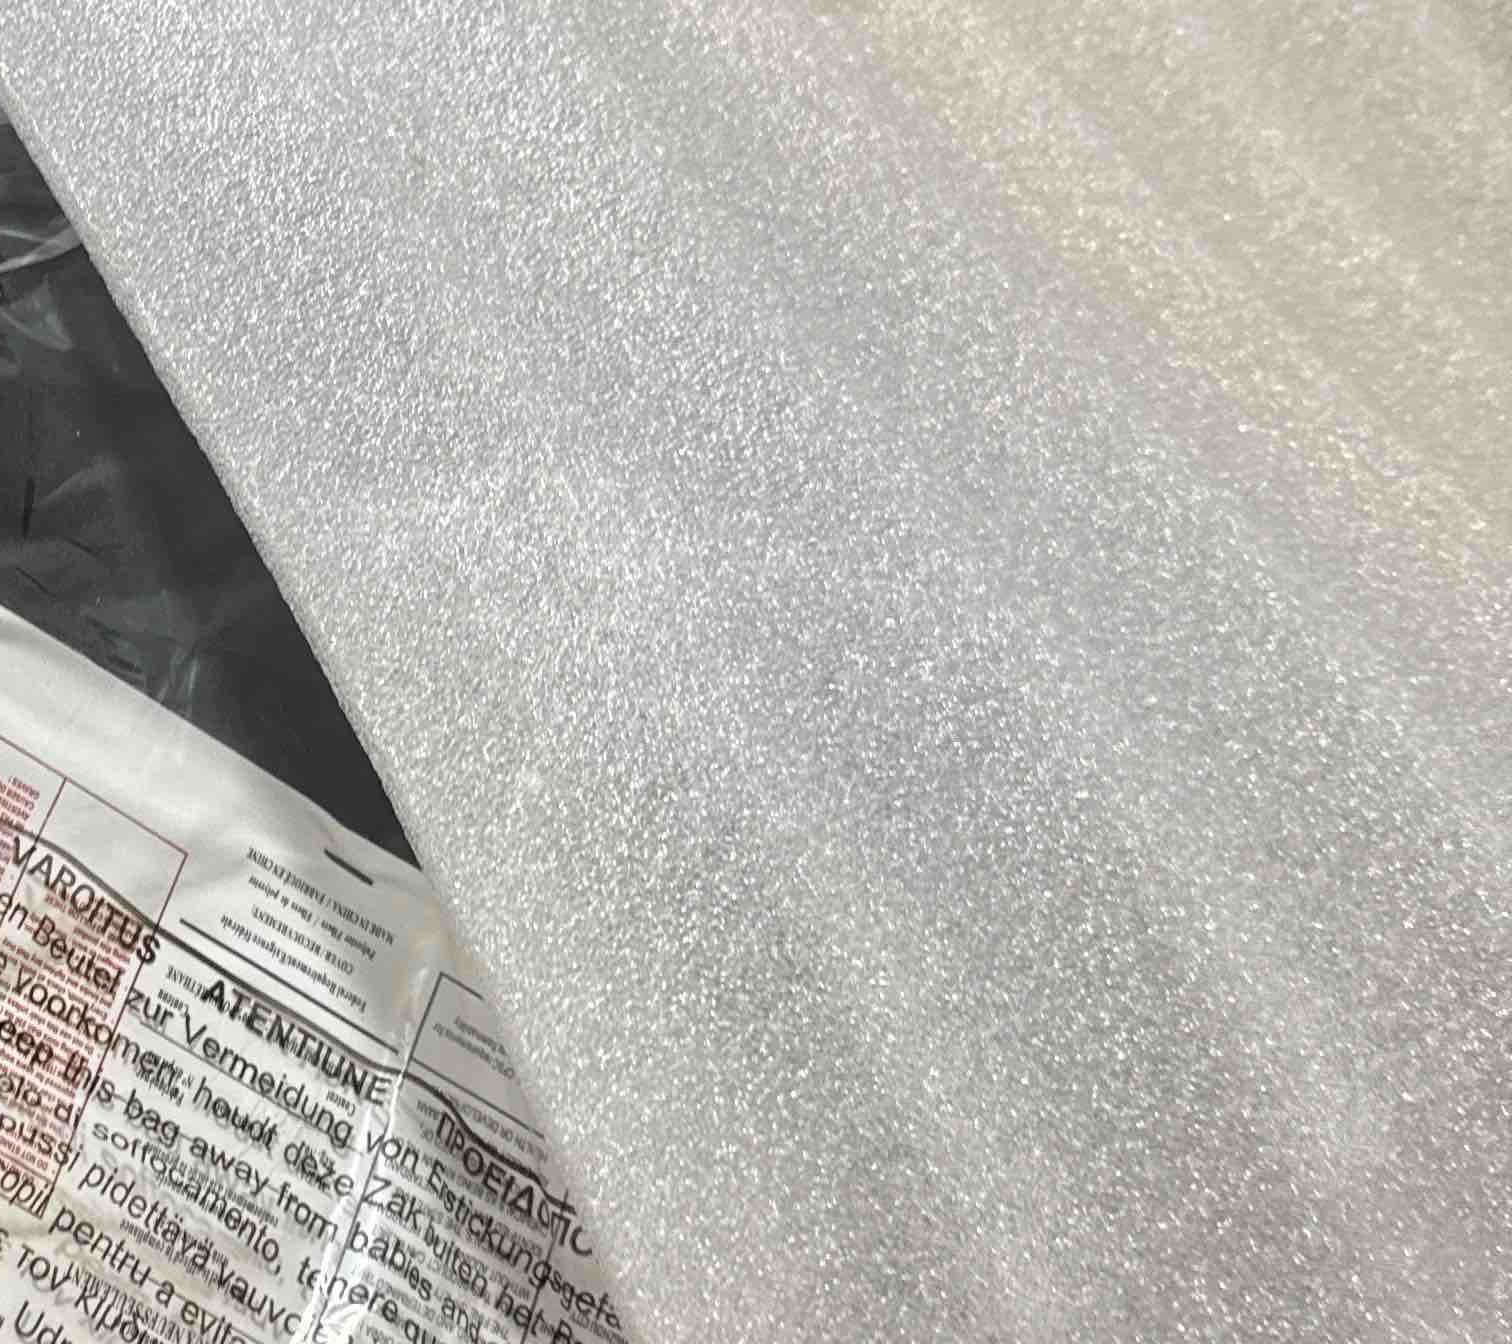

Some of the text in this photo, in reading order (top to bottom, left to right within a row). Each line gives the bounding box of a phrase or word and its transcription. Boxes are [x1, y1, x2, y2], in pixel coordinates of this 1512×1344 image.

[3, 834, 168, 968] VAROITUS
[199, 972, 398, 1110] ATENTIUNE
[28, 914, 128, 999] Beutel
[123, 982, 177, 1031] zur
[170, 1012, 361, 1152] Vermeidung
[359, 1126, 425, 1172] von
[49, 1097, 88, 1131] di
[56, 1047, 123, 1106] this
[117, 1090, 185, 1153] bag
[182, 1135, 271, 1206] away
[266, 1180, 343, 1245] from
[344, 1219, 439, 1302] babies
[76, 1156, 227, 1272] pidettävä
[185, 1078, 281, 1154] houdt
[276, 1135, 357, 1202] deze
[360, 1173, 432, 1229] Zak
[421, 1216, 496, 1297] buiten
[492, 1286, 547, 1338] het
[47, 1203, 157, 1287] pentru
[152, 1280, 178, 1308] a
